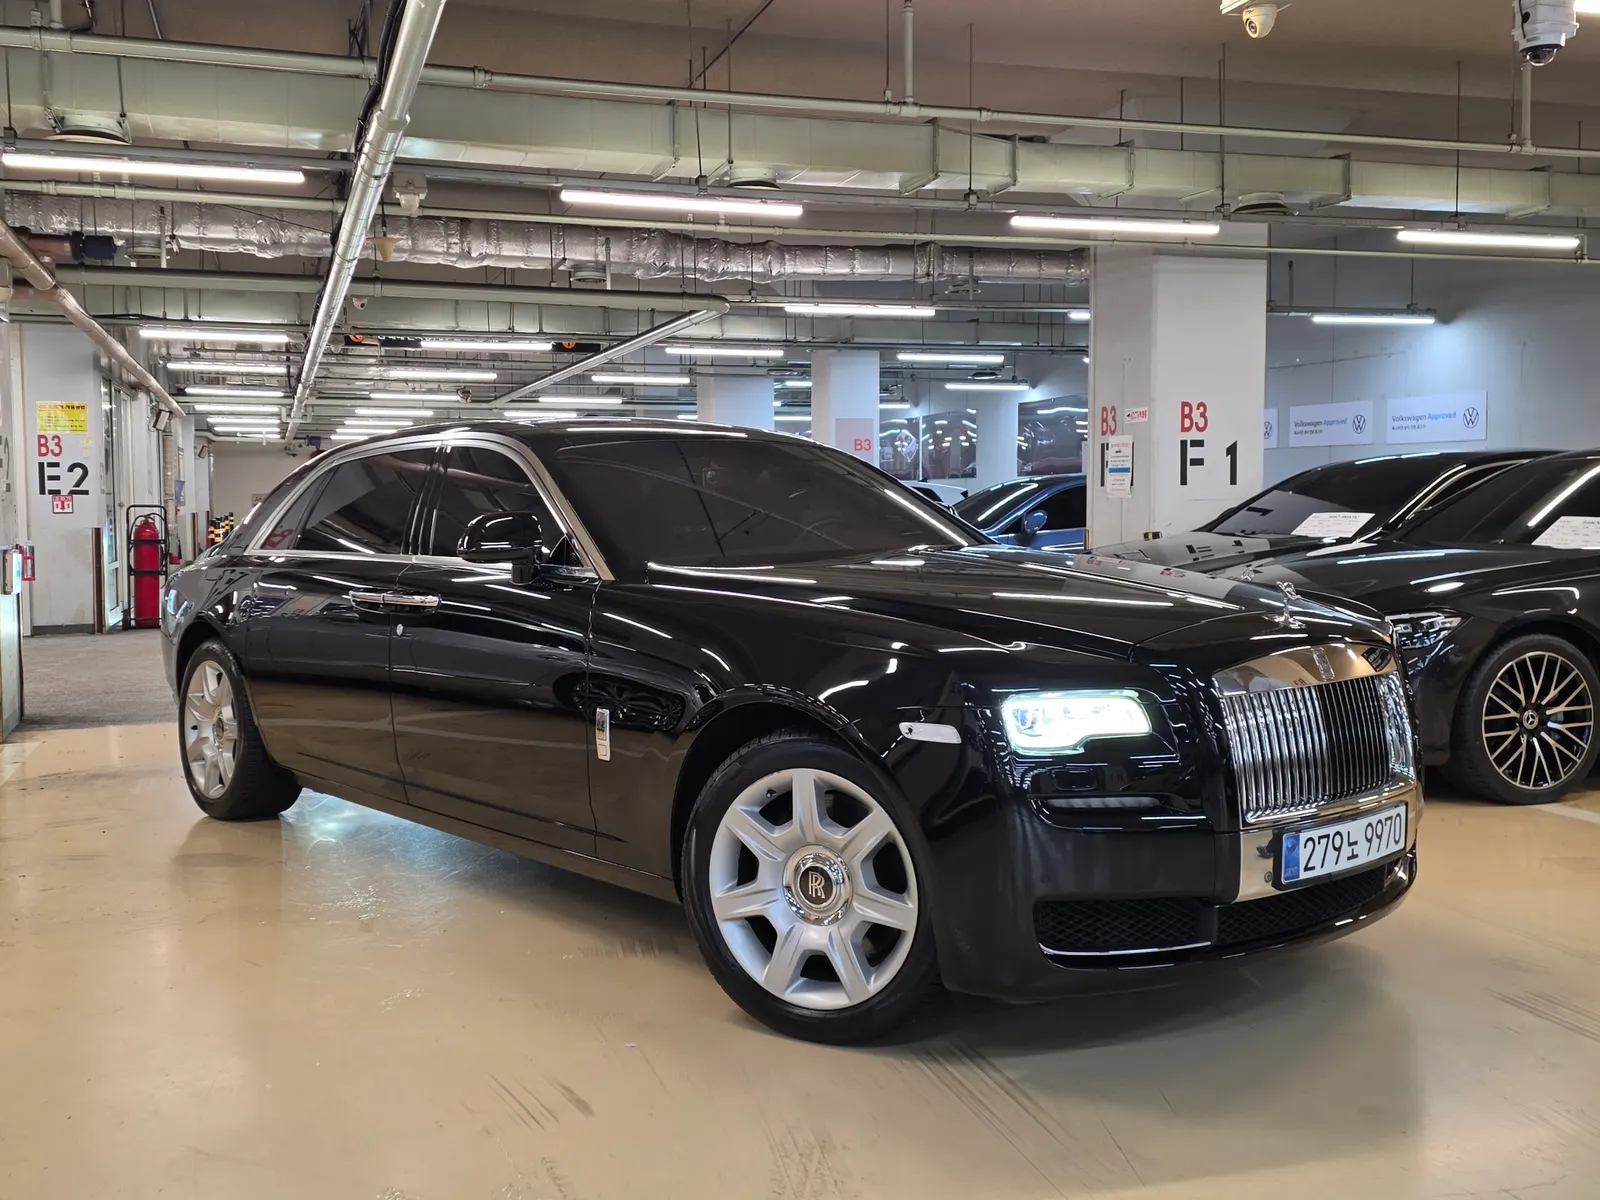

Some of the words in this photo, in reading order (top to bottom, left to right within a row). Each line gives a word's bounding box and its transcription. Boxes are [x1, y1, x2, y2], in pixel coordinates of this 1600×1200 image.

[1101, 405, 1117, 436] B3
[1181, 401, 1208, 433] B3
[1293, 420, 1323, 428] Volkswagen
[1323, 417, 1348, 427] Approved
[1391, 415, 1427, 423] Volkswagen
[1427, 410, 1457, 421] Approved
[37, 434, 63, 457] B3
[853, 438, 872, 451] B3
[37, 462, 90, 496] E2
[1303, 830, 1359, 873] 279노
[1364, 812, 1402, 857] 9970
